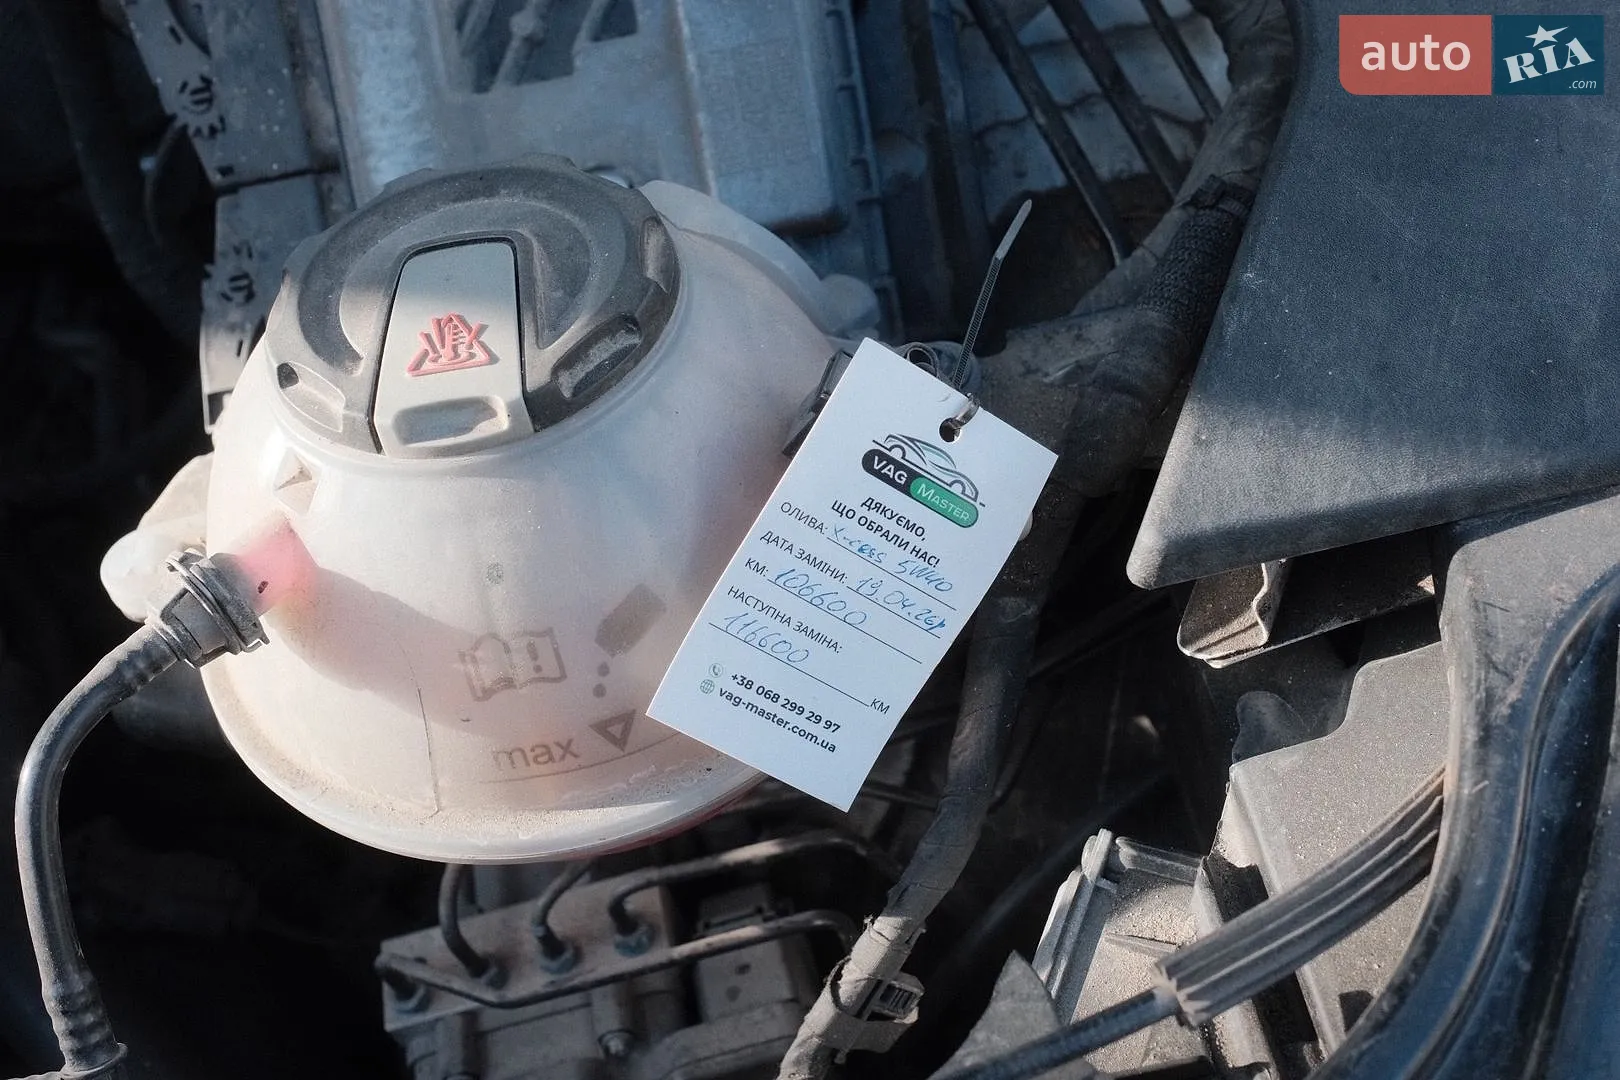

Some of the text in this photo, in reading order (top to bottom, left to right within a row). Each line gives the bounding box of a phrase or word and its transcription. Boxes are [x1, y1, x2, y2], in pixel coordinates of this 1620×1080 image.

[874, 456, 908, 485] VAG
[781, 502, 829, 536] ОЛИВА:
[831, 501, 941, 569] ЩО ОБРАЛИ НАС!
[860, 497, 928, 542] ДЯКУЄМО,
[745, 558, 769, 578] КМ:
[760, 531, 848, 584] ДАТА ЗАМІНИ:
[728, 586, 843, 655] НАСТУПНА ЗАМІНА:
[773, 569, 867, 627] 106600
[723, 612, 810, 664] 116600
[720, 688, 837, 753] vag-master.com.ua
[730, 673, 842, 734] +38 068 299 29 97
[870, 698, 891, 715] КМ
[493, 738, 581, 770] max
